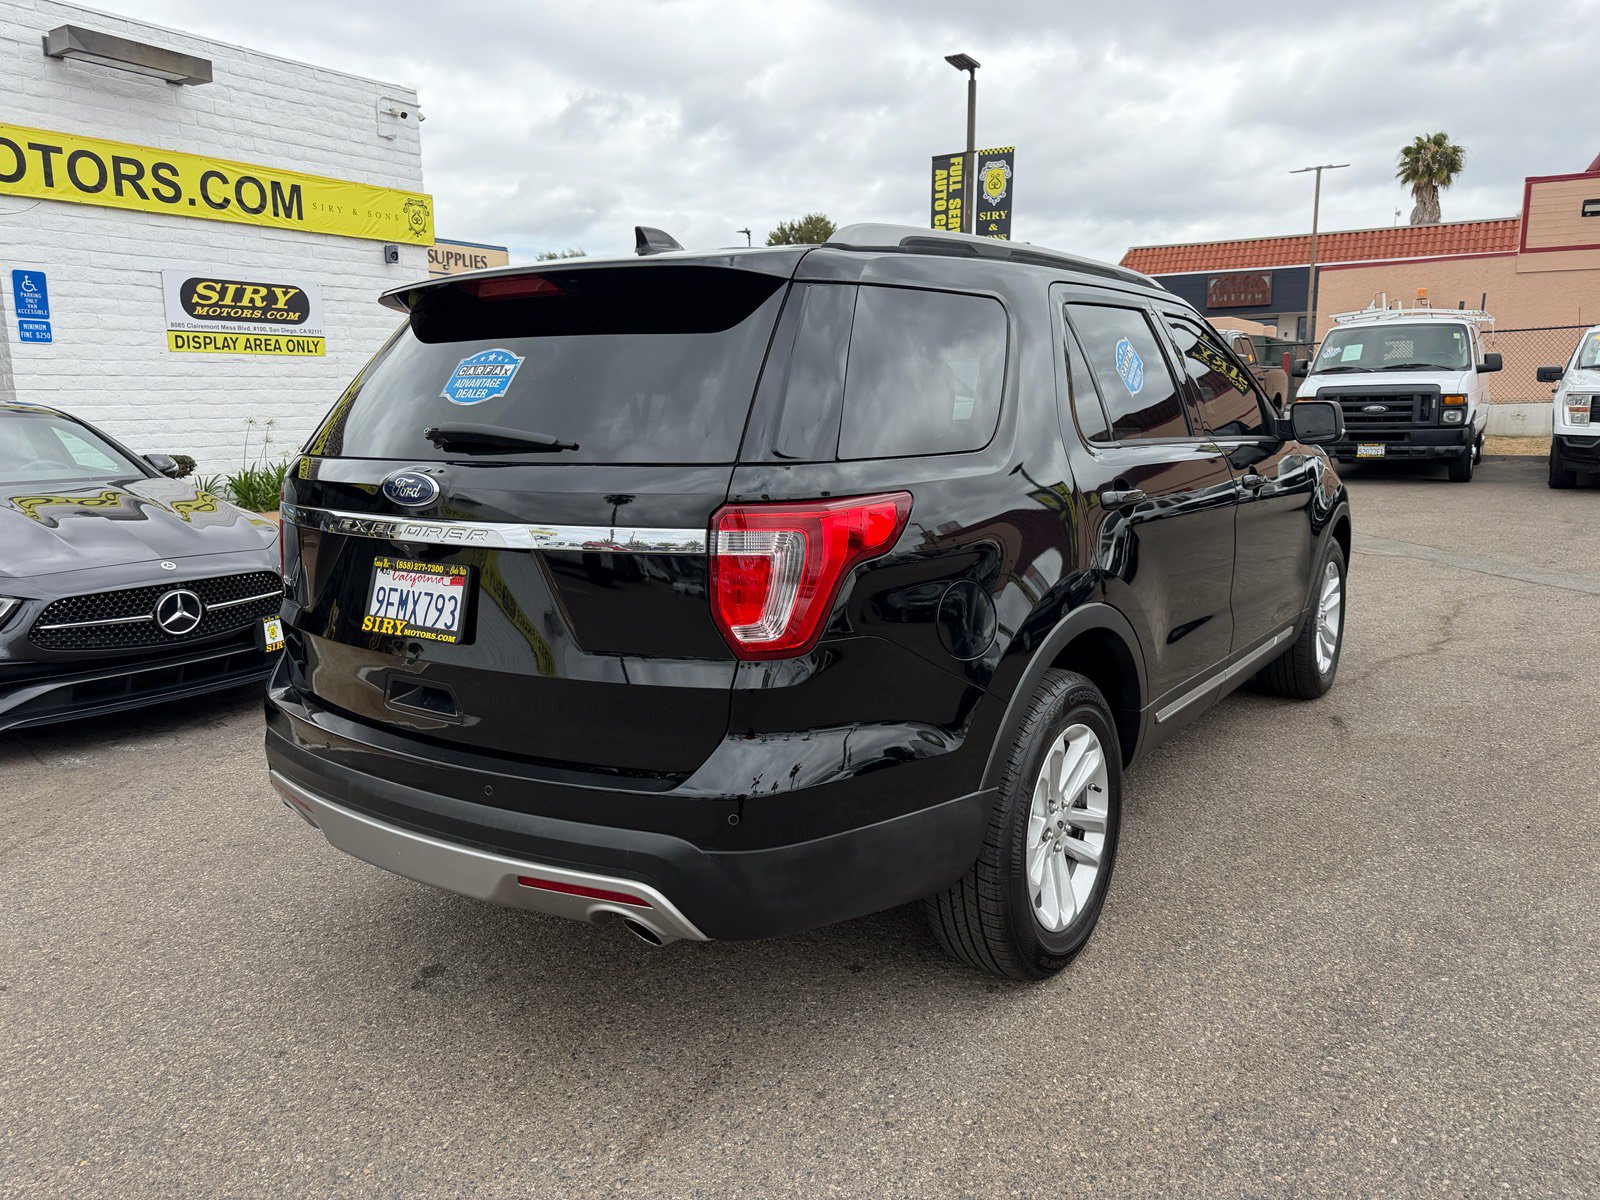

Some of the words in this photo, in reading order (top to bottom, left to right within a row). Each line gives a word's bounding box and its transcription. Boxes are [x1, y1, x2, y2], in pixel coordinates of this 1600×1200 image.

[949, 157, 963, 192] FULL
[934, 170, 948, 211] AUTO
[313, 203, 343, 214] SIRY
[368, 210, 400, 221] SONS
[979, 210, 1008, 221] SIRY
[988, 223, 998, 231] &
[428, 248, 488, 270] SUPPLIES
[191, 281, 300, 309] SIRY
[193, 306, 301, 321] MOTORS.COM
[187, 322, 220, 330] Clairemont
[174, 335, 239, 350] DISPLAY
[244, 338, 282, 352] AREA
[285, 340, 320, 354] ONLY
[458, 365, 512, 376] CARFAX
[453, 379, 503, 388] ADVANTAGE
[455, 389, 488, 398] DEALER
[391, 477, 422, 498] Ford
[338, 518, 489, 542] EXPLORER
[396, 559, 414, 568] (858)
[414, 563, 444, 574] 277-7300
[392, 570, 450, 588] California
[362, 615, 407, 636] SIRY
[403, 628, 457, 643] MOTORS.COM
